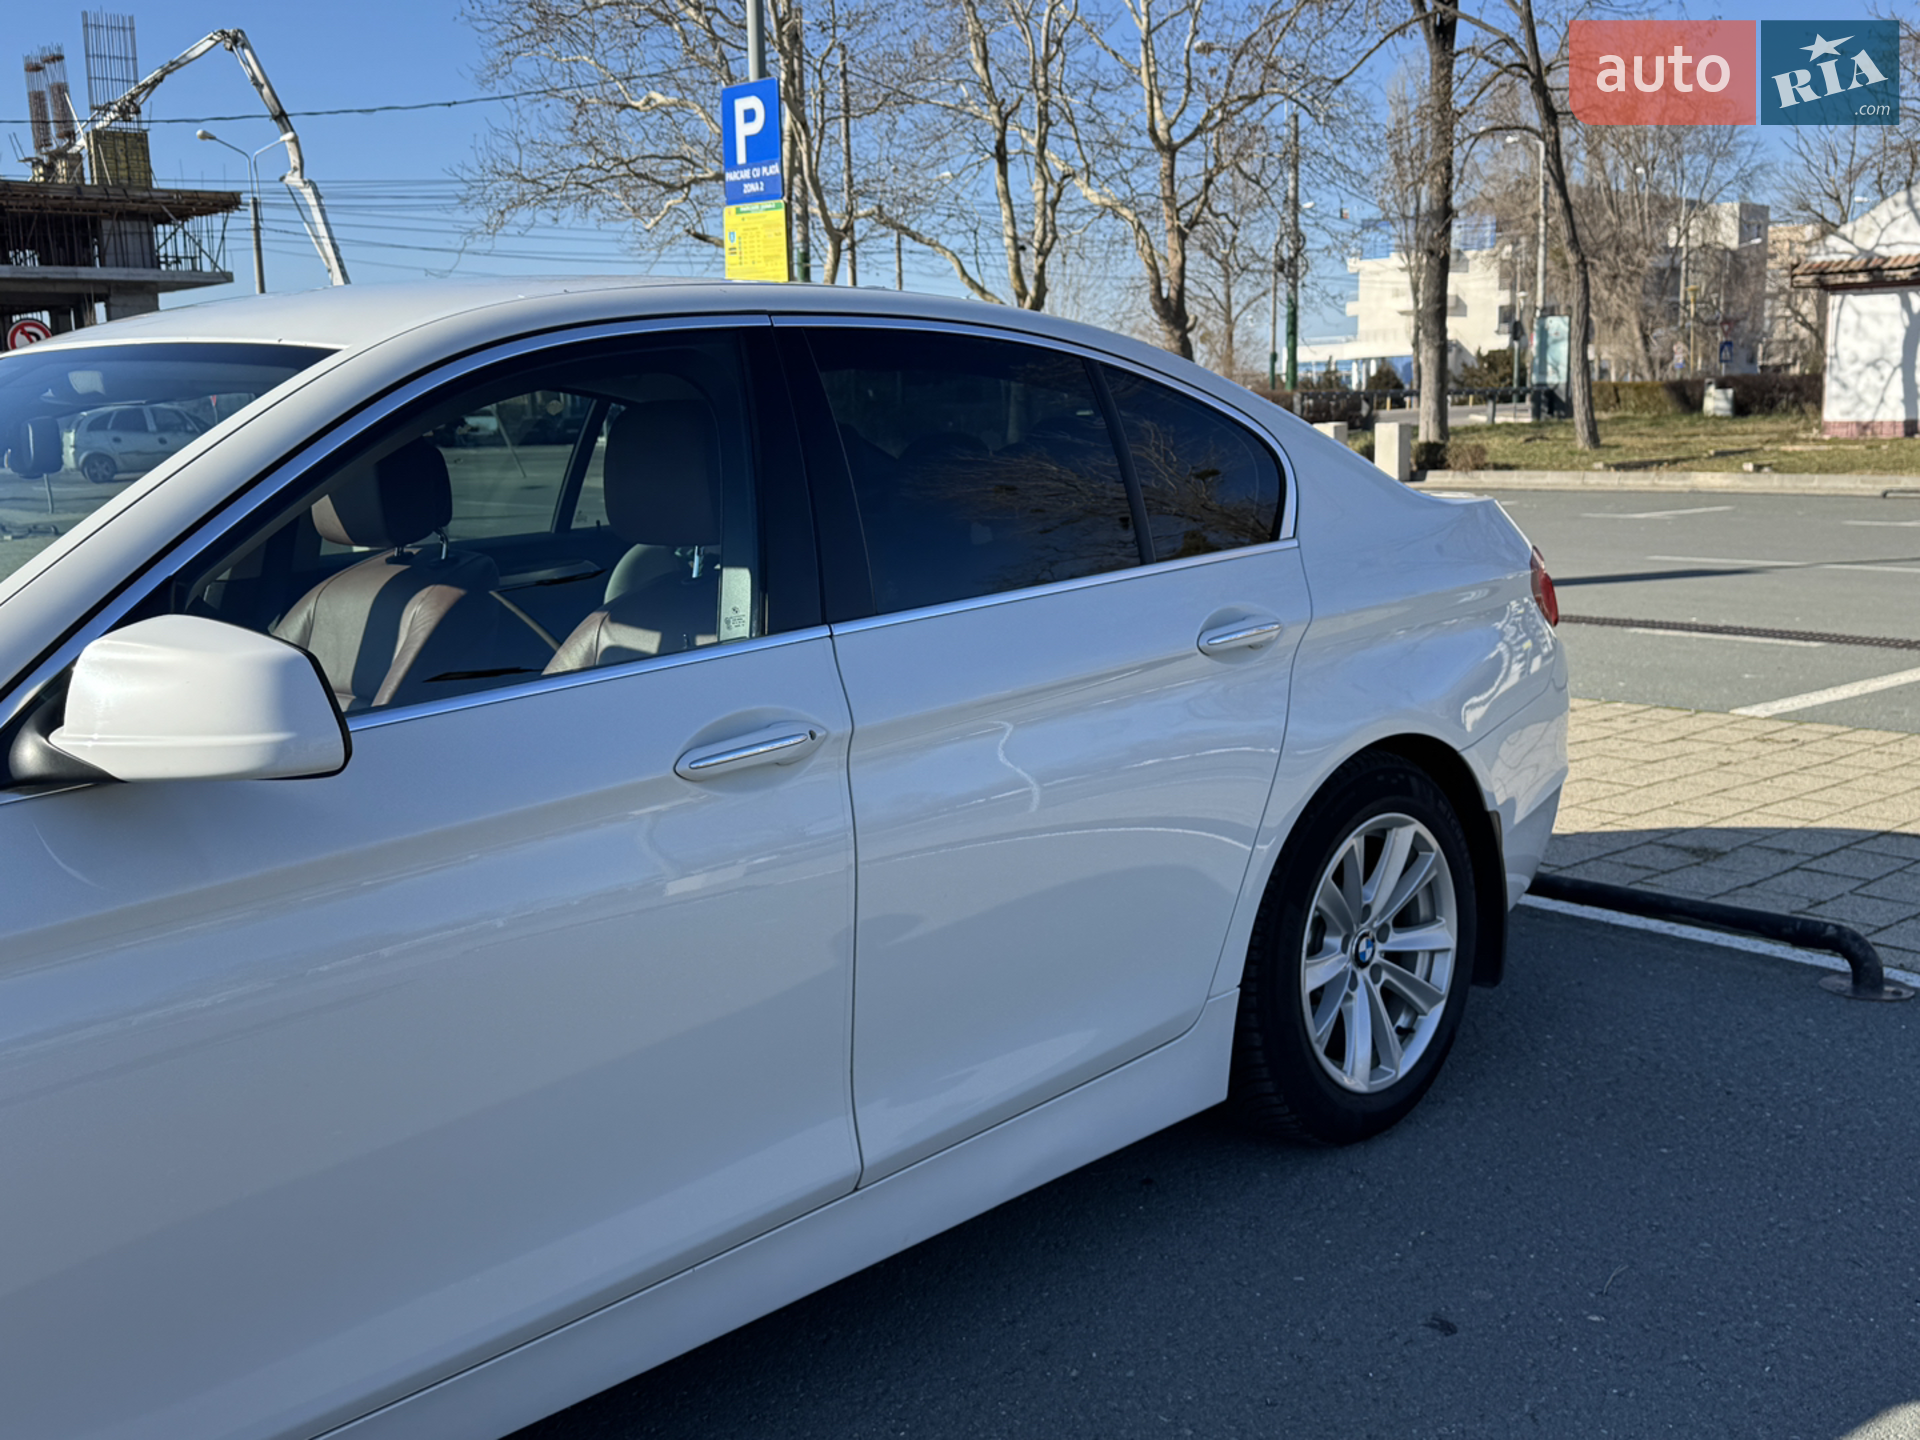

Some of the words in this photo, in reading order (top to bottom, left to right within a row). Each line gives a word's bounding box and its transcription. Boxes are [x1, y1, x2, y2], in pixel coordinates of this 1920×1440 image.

[734, 95, 765, 165] P
[725, 168, 751, 182] PARCARE
[752, 167, 761, 179] CU
[743, 181, 760, 195] ZONA
[760, 180, 765, 192] 2
